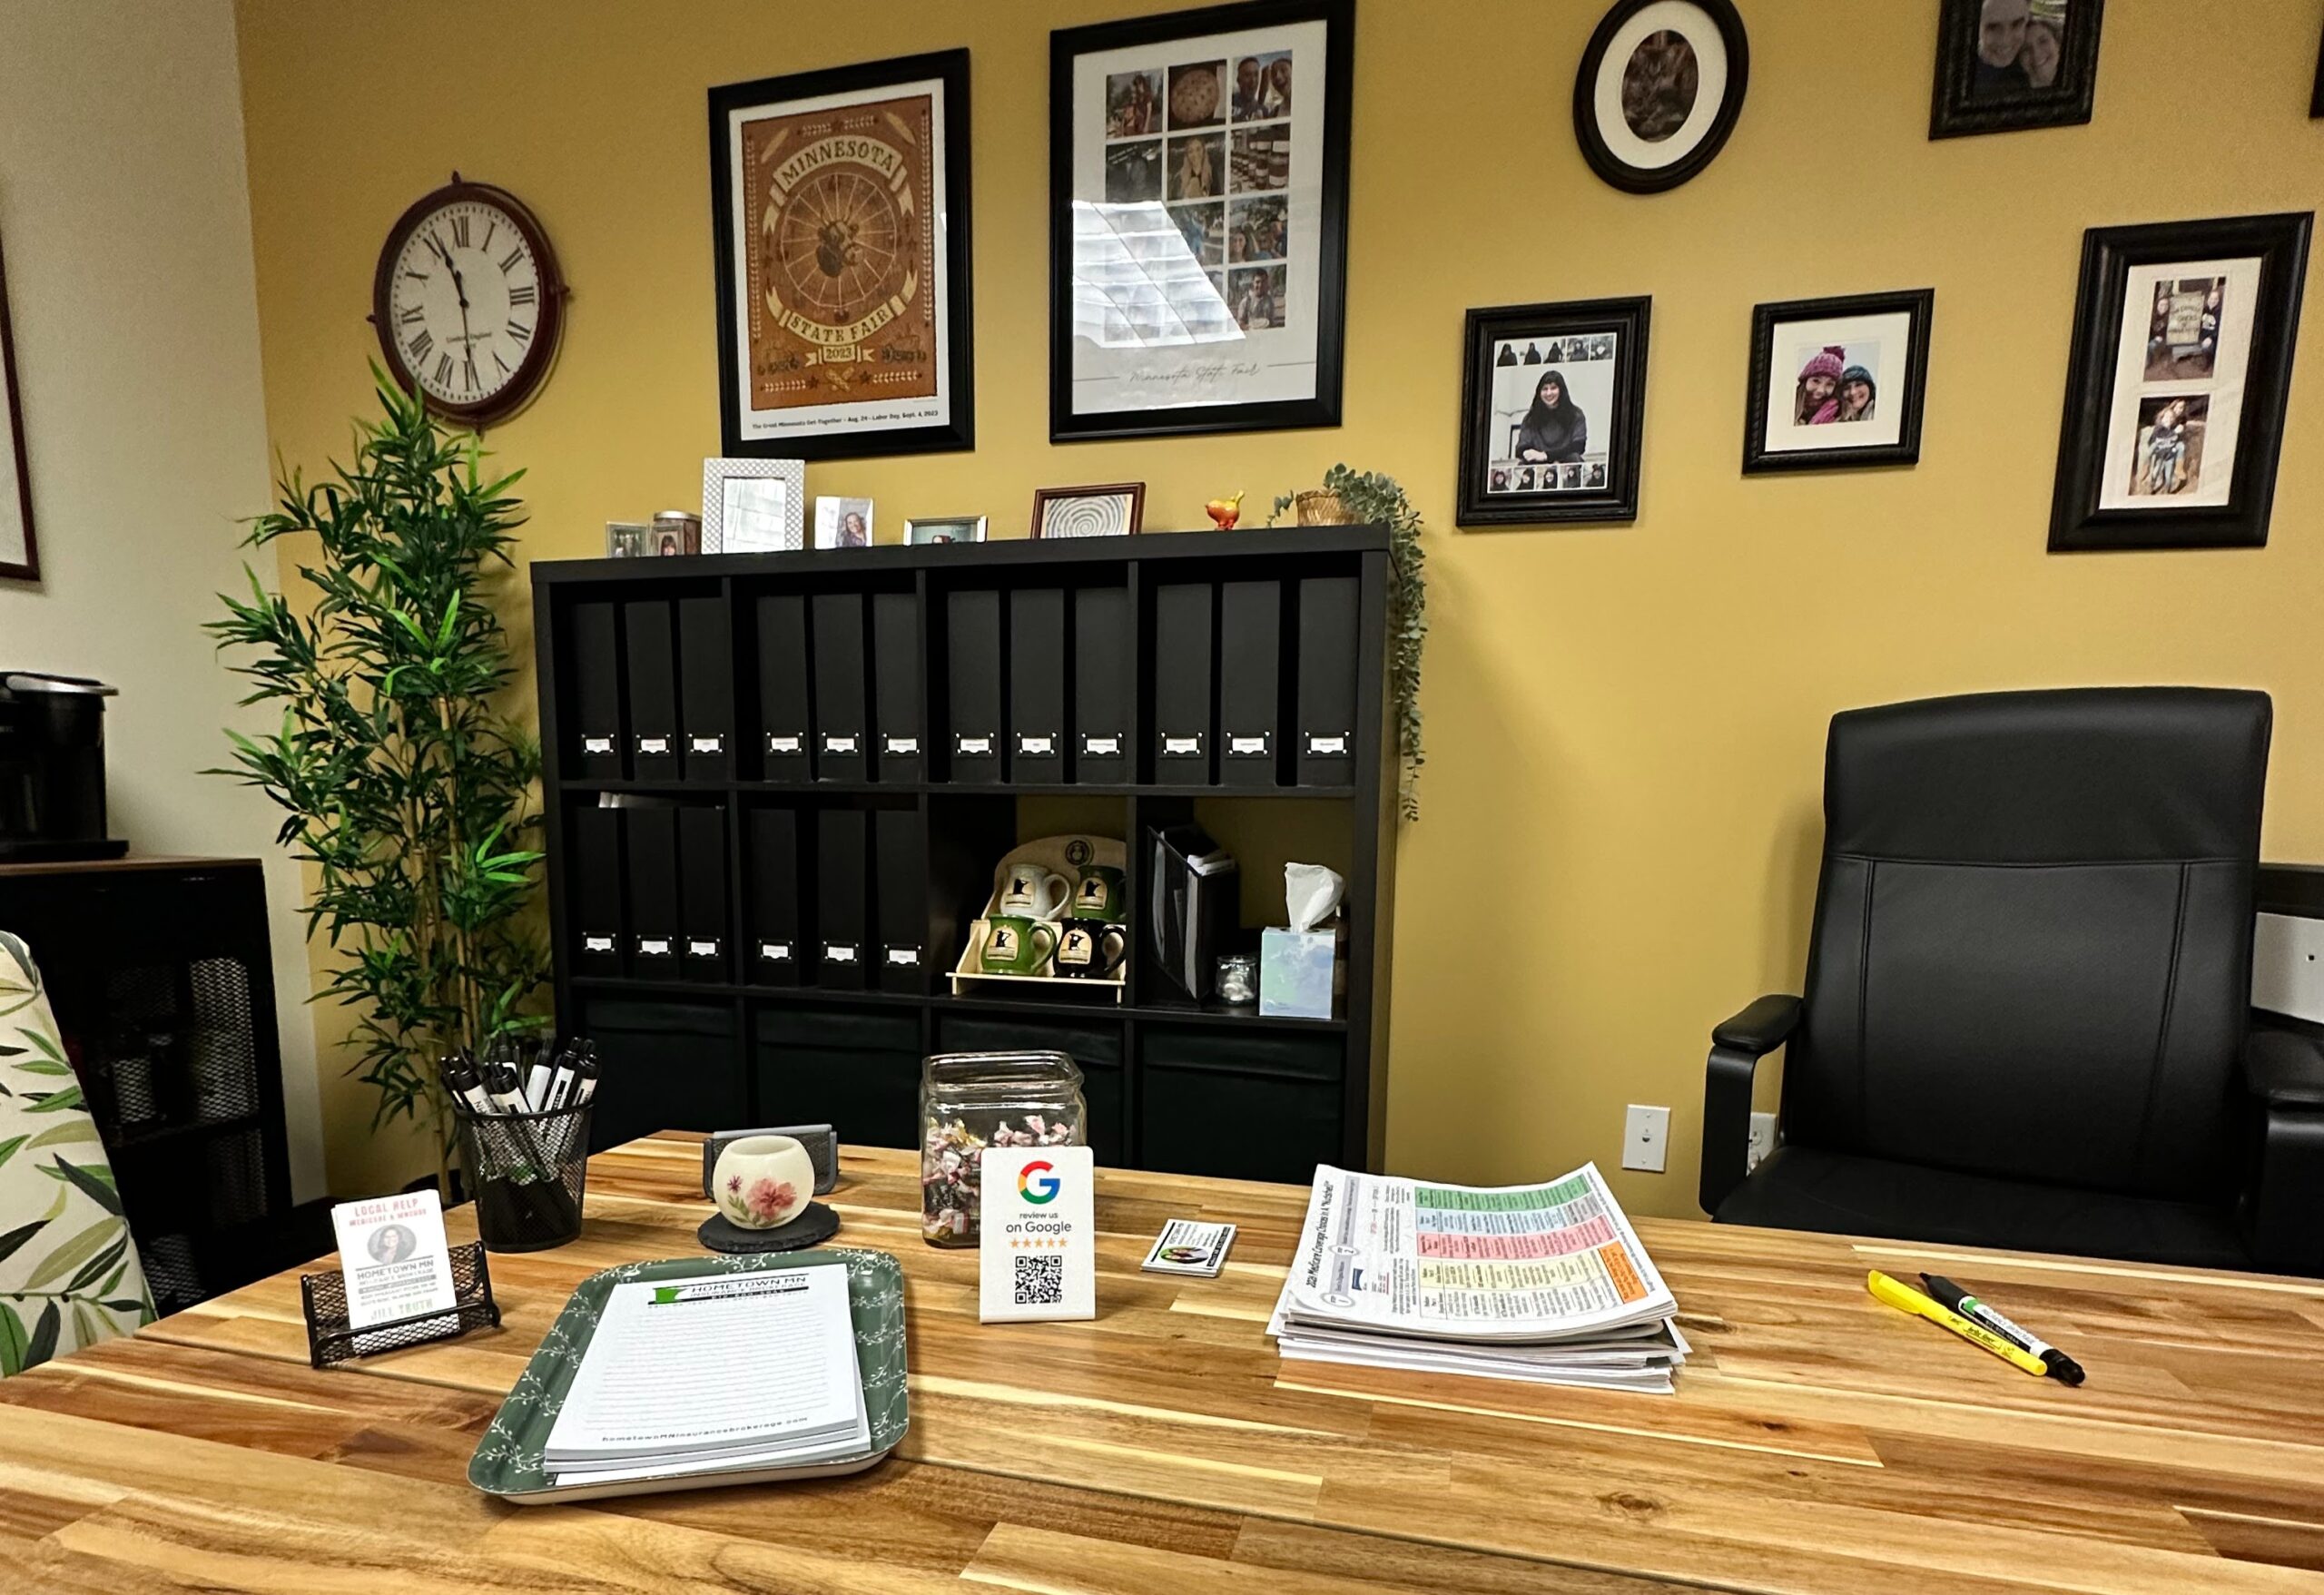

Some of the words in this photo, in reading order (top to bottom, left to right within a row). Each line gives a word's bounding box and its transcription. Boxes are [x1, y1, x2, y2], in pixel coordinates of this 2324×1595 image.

[782, 139, 894, 184] MINNESOTA
[790, 316, 844, 342] STATE
[850, 308, 890, 340] FAIR
[825, 347, 852, 359] 2023
[355, 1204, 388, 1216] LOCAL
[393, 1198, 419, 1211] HELP
[1006, 1224, 1022, 1233] on
[1025, 1221, 1072, 1235] Google
[1316, 1216, 1329, 1233] Choices
[1312, 1232, 1328, 1255] Coverage
[357, 1264, 417, 1279] HOMETOWN
[419, 1259, 434, 1268] MN
[1307, 1255, 1321, 1276] Medicare
[692, 1279, 780, 1293] HOMETOWN
